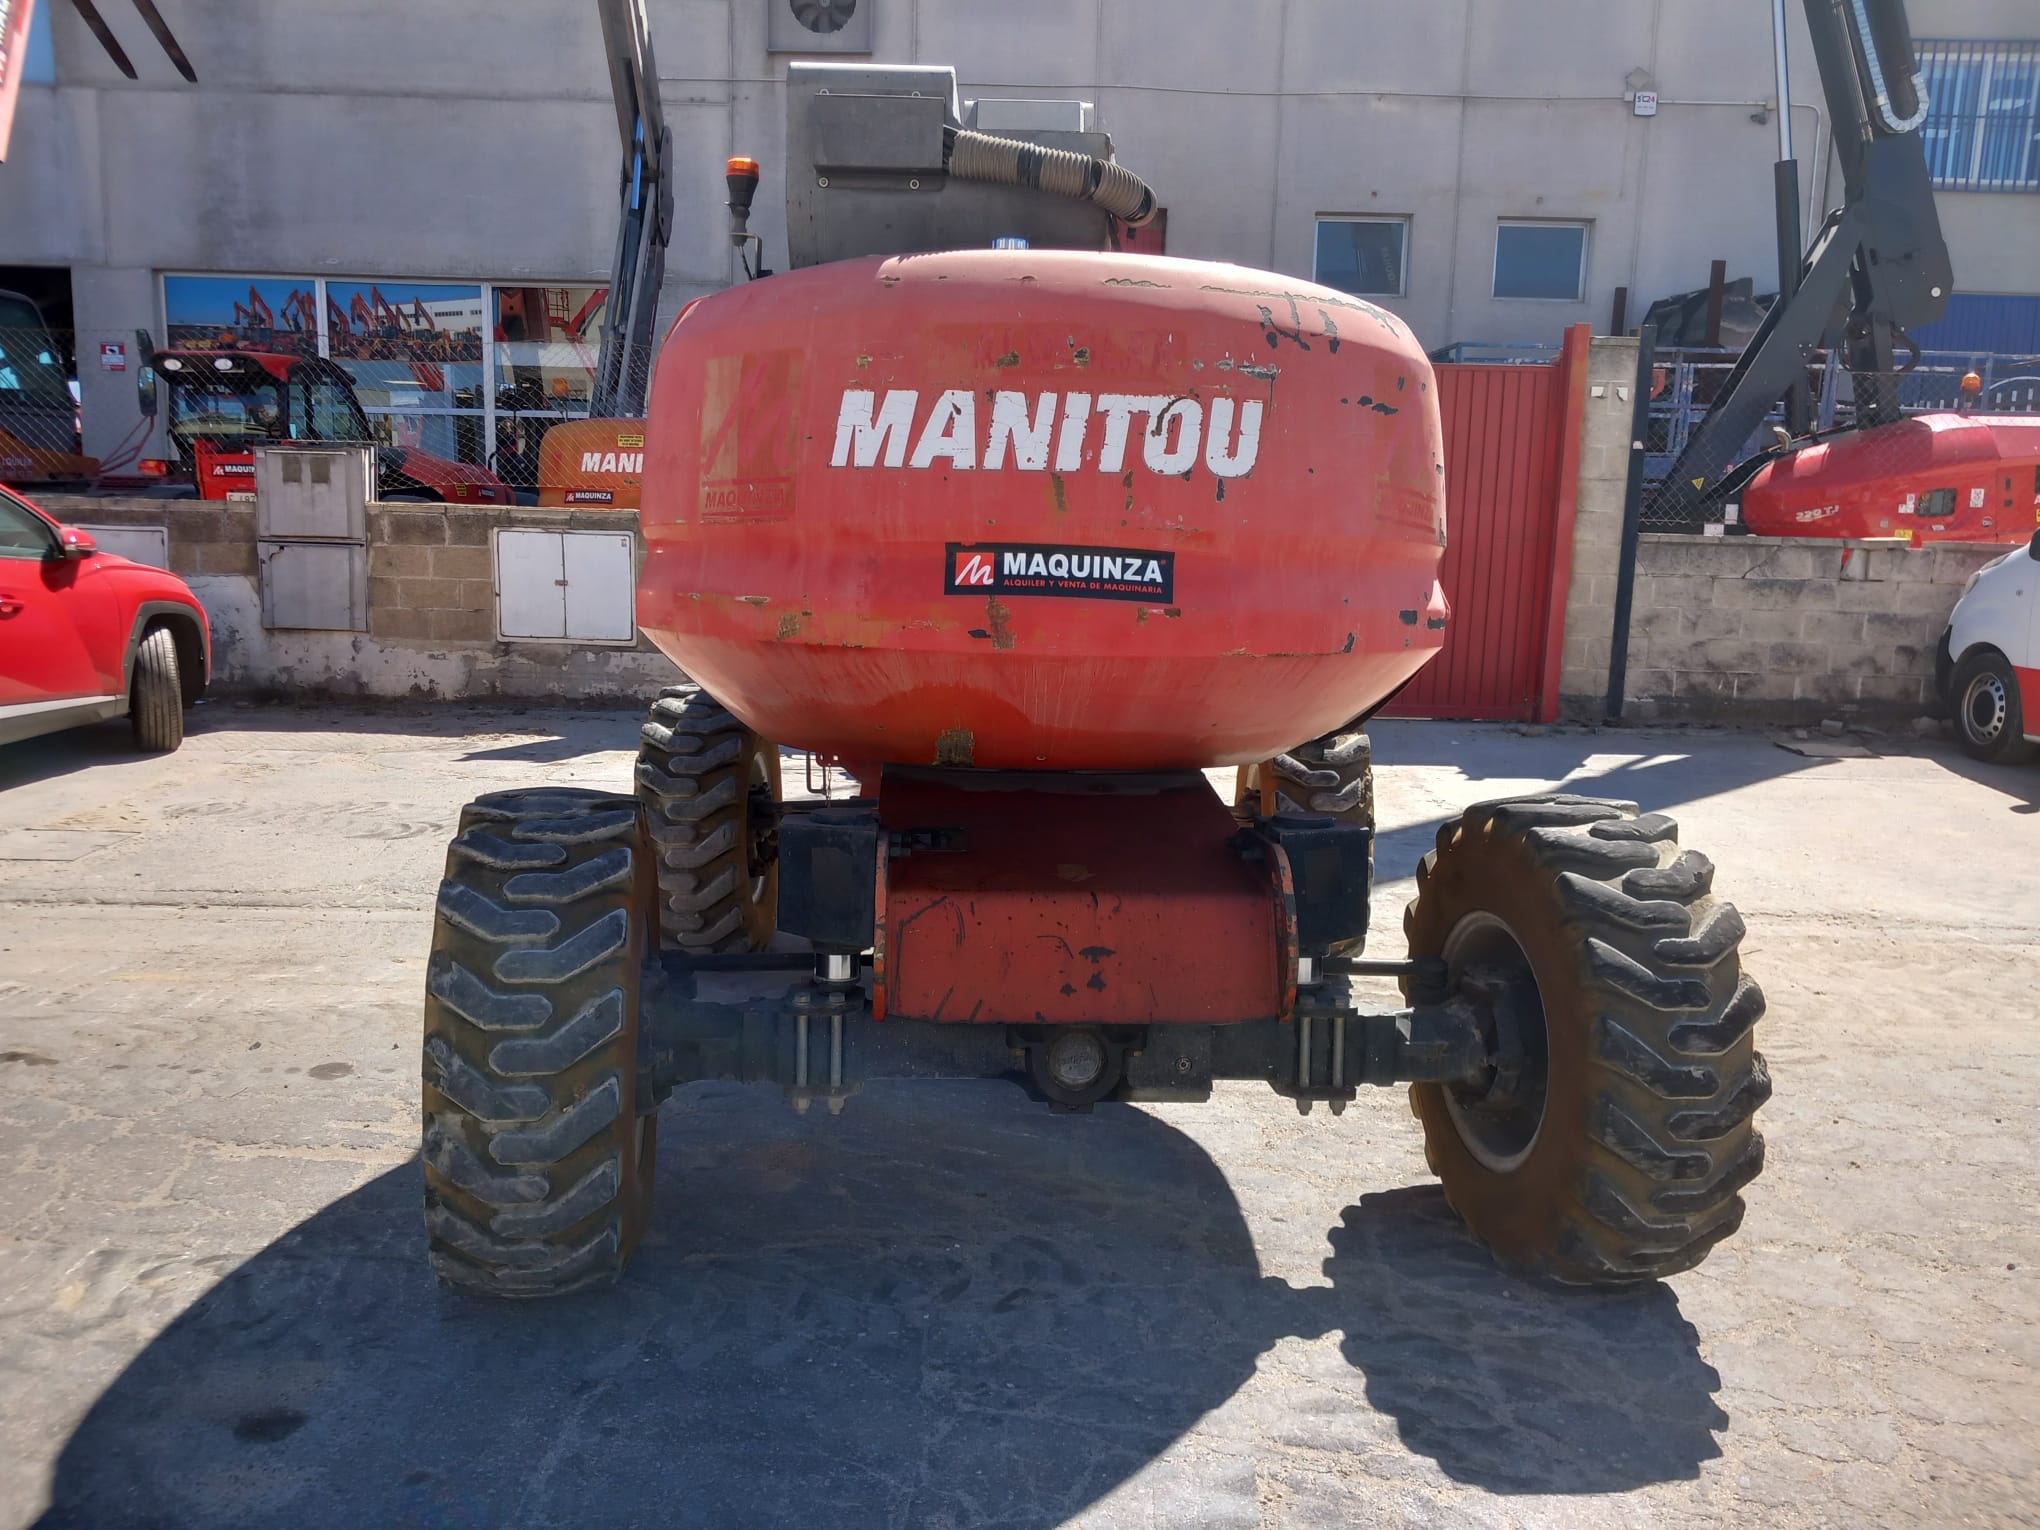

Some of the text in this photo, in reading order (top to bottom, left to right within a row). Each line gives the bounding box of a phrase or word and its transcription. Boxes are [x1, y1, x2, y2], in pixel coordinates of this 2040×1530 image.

[828, 389, 1263, 478] MANITOU
[581, 452, 644, 473] MANI
[1003, 552, 1163, 584] MAQUINZA
[1004, 579, 1045, 587] ALQUILER
[1058, 581, 1086, 589] VENTA
[1103, 583, 1163, 594] MAQUINARIA
